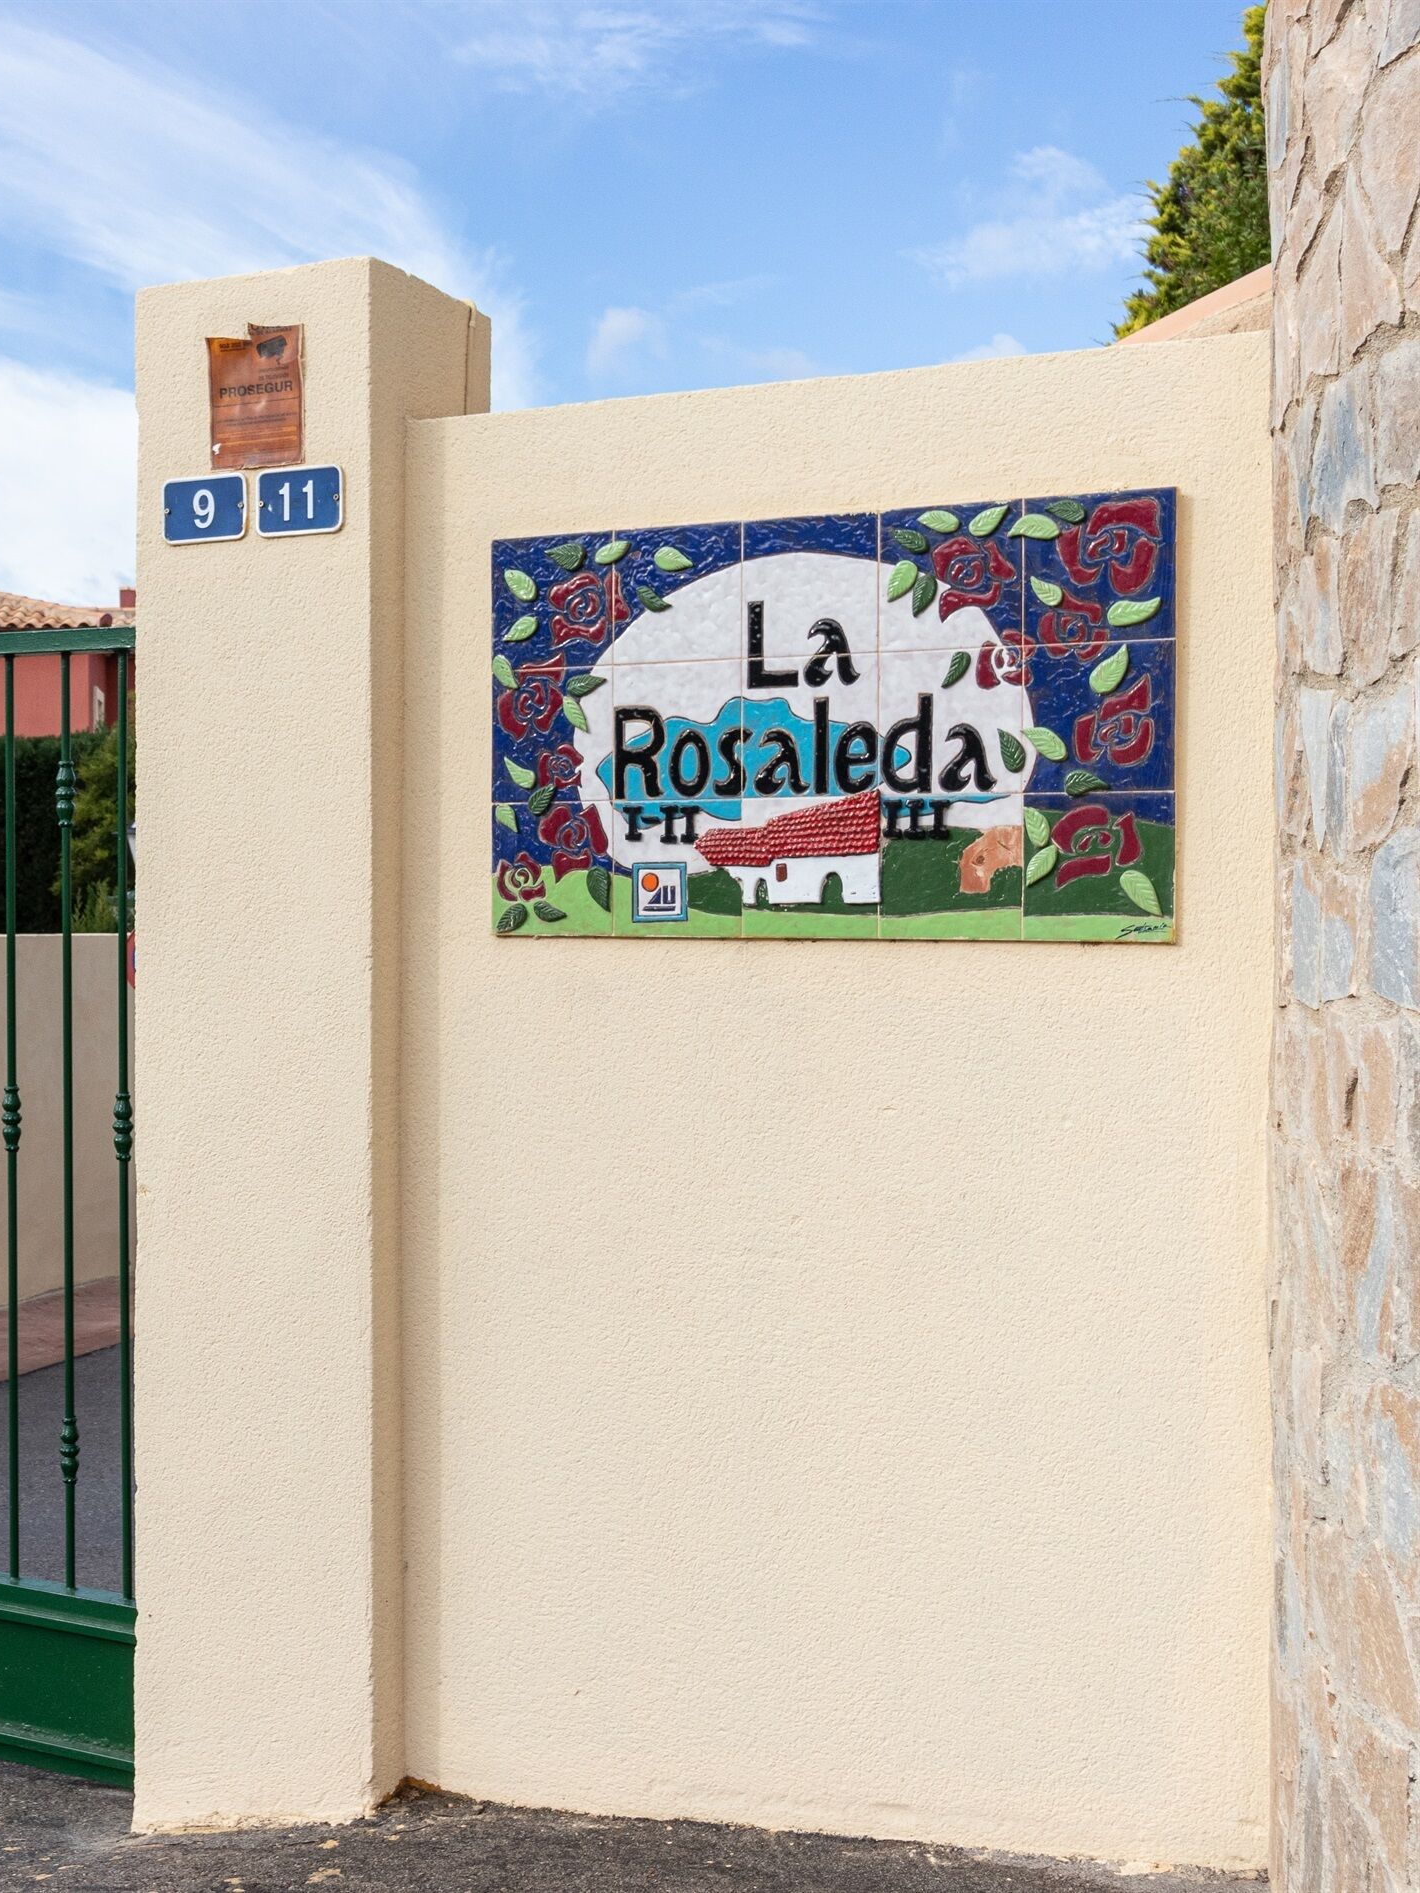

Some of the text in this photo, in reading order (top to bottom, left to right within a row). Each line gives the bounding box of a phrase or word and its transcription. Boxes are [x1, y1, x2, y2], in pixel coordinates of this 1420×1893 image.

[219, 381, 293, 399] PROSEGUR
[192, 489, 215, 529] 9
[278, 480, 314, 522] 11
[747, 600, 861, 689] La
[613, 692, 998, 800] Rosaleda
[624, 798, 950, 843] I-II III
